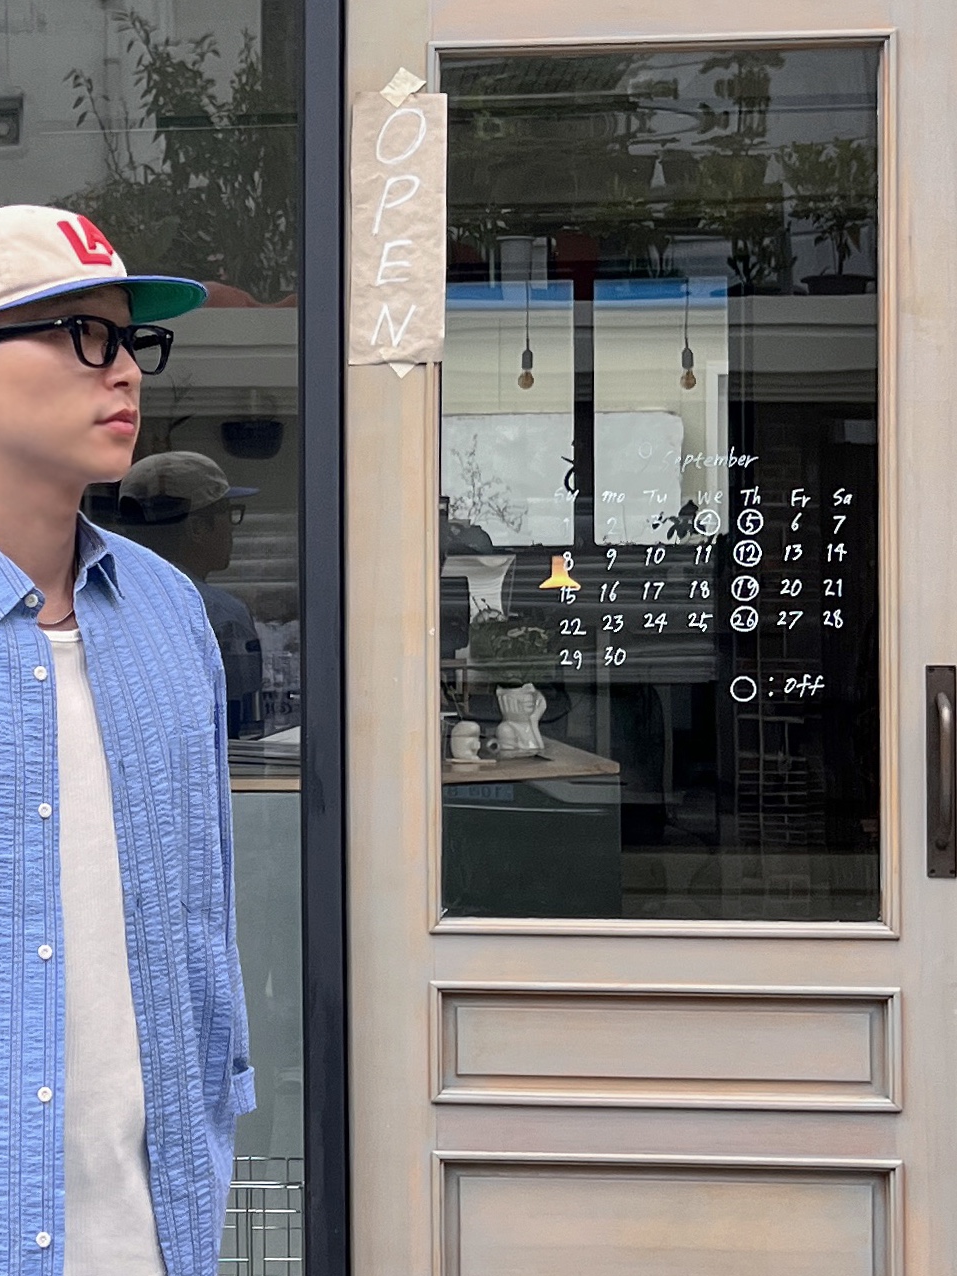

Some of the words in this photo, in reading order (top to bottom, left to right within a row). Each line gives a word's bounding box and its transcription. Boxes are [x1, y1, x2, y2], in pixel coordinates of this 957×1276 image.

[57, 214, 113, 266] LA
[370, 108, 427, 348] OPEN
[643, 489, 668, 504] Tu
[697, 490, 724, 505] We
[740, 486, 761, 506] Th
[791, 488, 811, 507] Fr
[833, 488, 853, 506] Sa
[606, 517, 619, 535] 2
[791, 512, 803, 531] 6
[833, 515, 846, 534] 7
[563, 551, 575, 571] 8
[606, 548, 618, 570] 9
[645, 546, 666, 566] 10
[695, 544, 712, 565] 11
[738, 544, 758, 562] 12
[784, 544, 803, 562] 13
[827, 543, 847, 562] 14
[560, 586, 577, 605] 15
[600, 581, 620, 603] 16
[643, 581, 665, 600] 17
[689, 580, 711, 599] 18
[737, 579, 757, 597] 19
[780, 579, 802, 597] 20
[823, 578, 843, 597] 21
[560, 618, 587, 635] 22
[602, 614, 624, 633] 23
[644, 612, 668, 633] 24
[688, 612, 713, 632] 25
[777, 611, 804, 630] 27
[823, 609, 843, 629] 28
[560, 649, 582, 670] 29
[604, 646, 627, 666] 30
